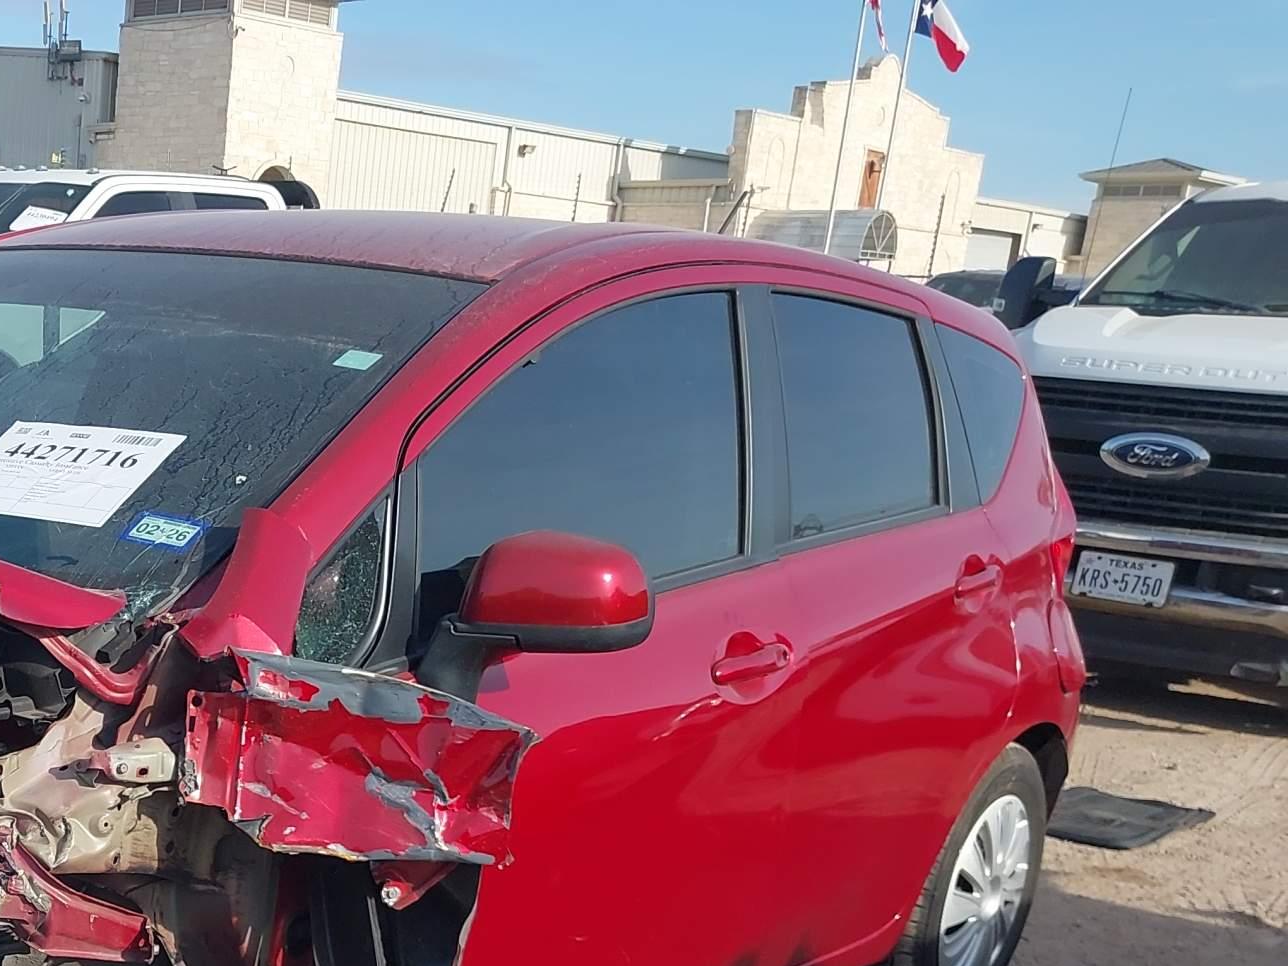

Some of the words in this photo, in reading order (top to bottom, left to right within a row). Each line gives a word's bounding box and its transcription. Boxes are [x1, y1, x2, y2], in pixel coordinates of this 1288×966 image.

[1060, 356, 1193, 376] SUPER
[4, 442, 145, 469] 44271716
[1127, 443, 1181, 468] Ford
[135, 522, 161, 536] 02
[1108, 559, 1145, 571] TEXAS
